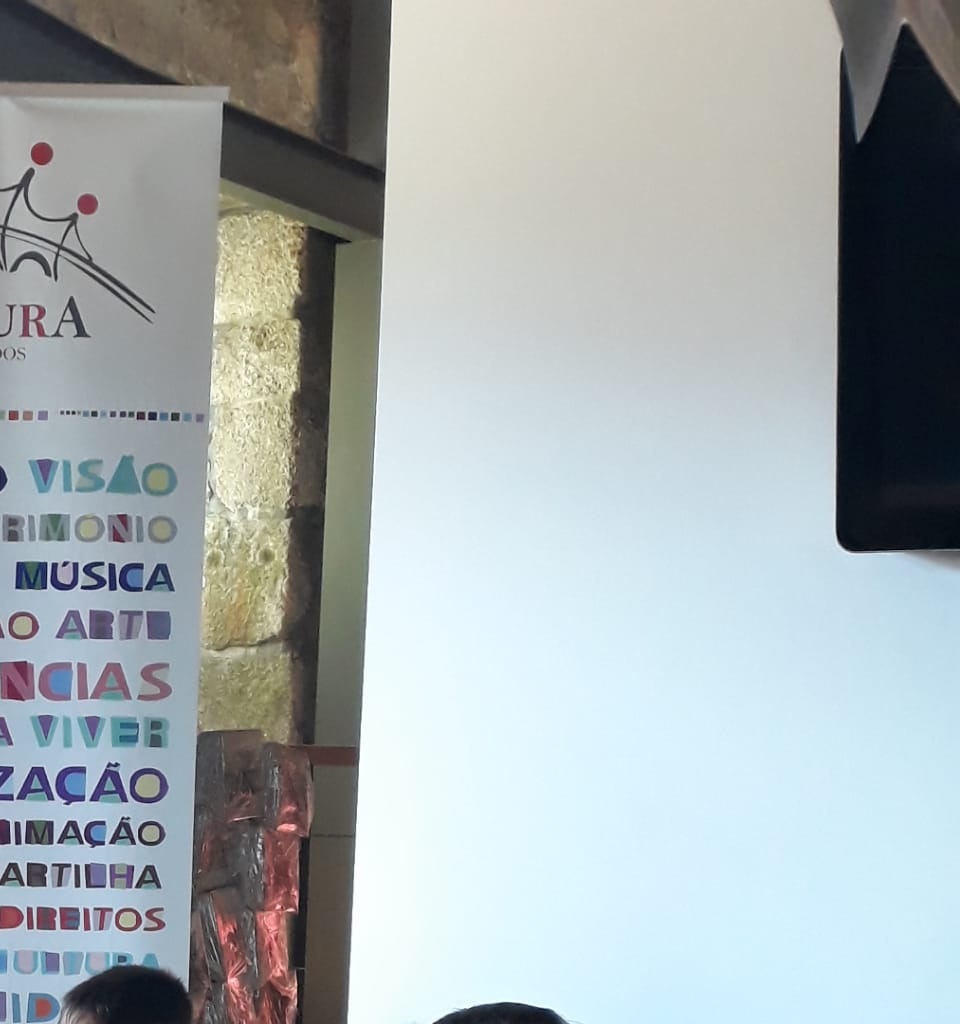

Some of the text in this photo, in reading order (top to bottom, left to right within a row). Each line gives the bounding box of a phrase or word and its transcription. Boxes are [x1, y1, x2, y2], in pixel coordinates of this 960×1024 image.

[28, 455, 178, 497] VISÃO
[15, 560, 176, 593] MÚSICA
[55, 608, 172, 641] ARTE
[29, 714, 170, 749] VIVER
